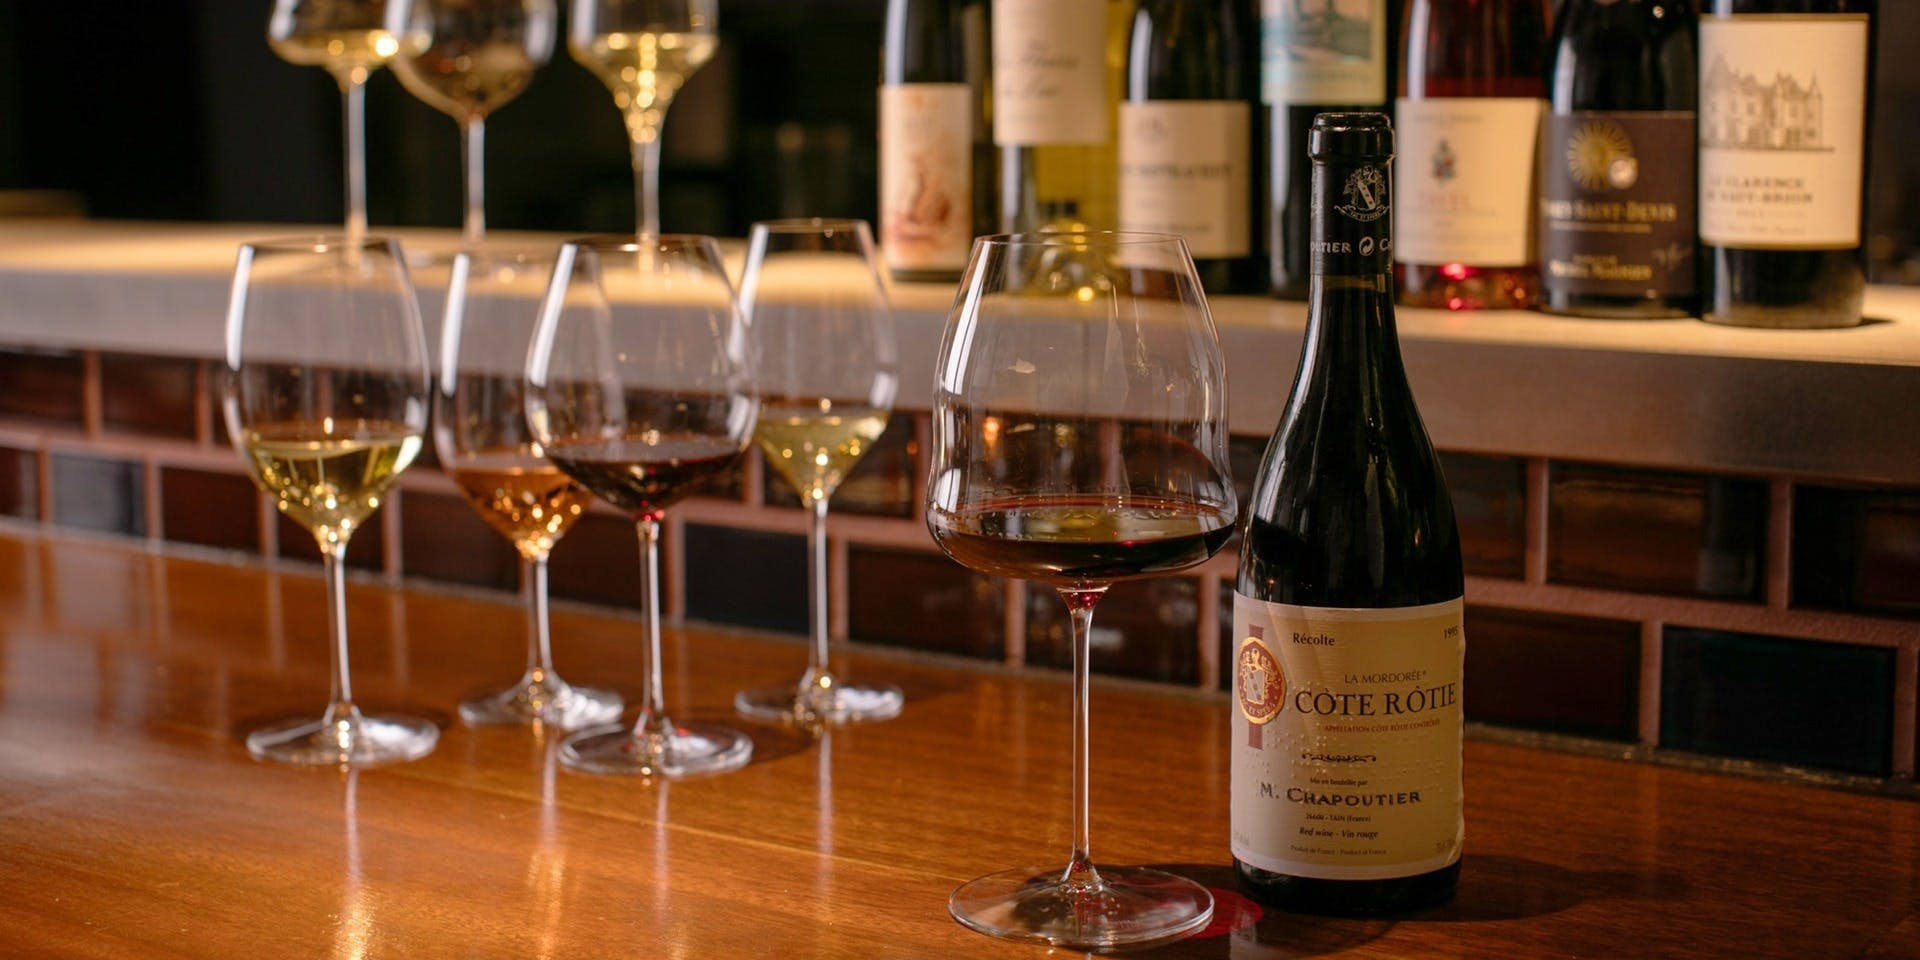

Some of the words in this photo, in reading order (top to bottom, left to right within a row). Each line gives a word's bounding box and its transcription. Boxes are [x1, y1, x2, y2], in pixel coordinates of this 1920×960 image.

[1293, 632, 1336, 646] Récolte
[1344, 674, 1358, 684] LA
[1384, 682, 1457, 715] RÔTIE
[1260, 781, 1280, 799] M.
[1286, 787, 1422, 807] CHAPOUTIER
[1299, 827, 1314, 836] Red
[1315, 829, 1333, 837] wine
[1342, 829, 1355, 838] Vin
[1356, 831, 1378, 840] rouge
